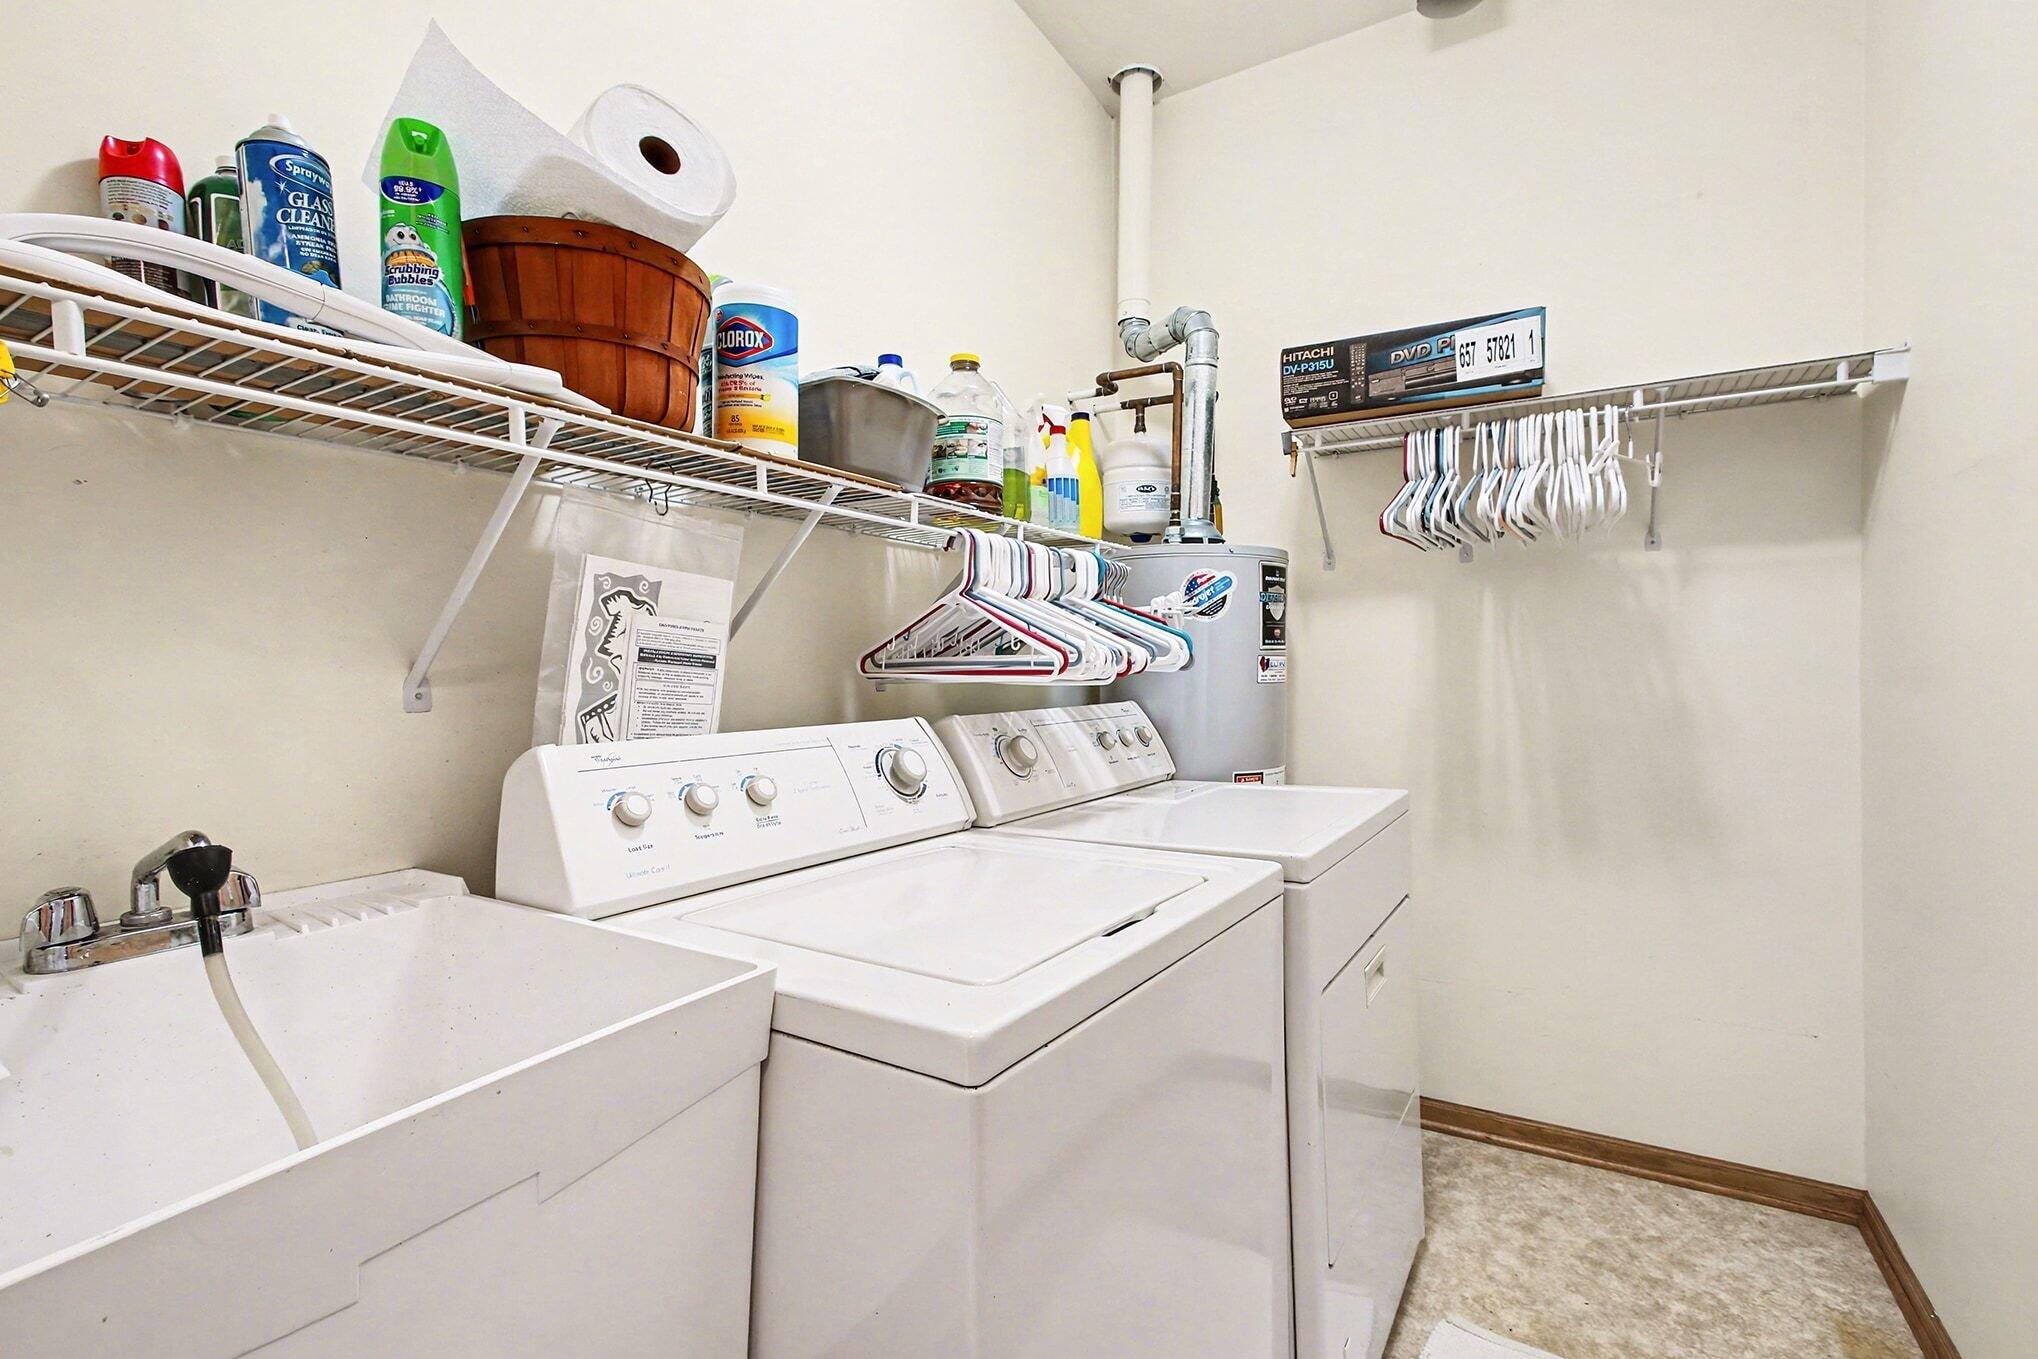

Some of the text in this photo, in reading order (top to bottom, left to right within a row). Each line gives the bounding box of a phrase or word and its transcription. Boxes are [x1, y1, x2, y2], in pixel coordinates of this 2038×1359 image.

[288, 191, 333, 216] GLASS
[384, 263, 440, 280] Scrubbing
[388, 273, 434, 286] Bubbles
[386, 294, 437, 307] BATHROOM
[405, 304, 446, 318] FIGHTER
[717, 330, 764, 350] CLOROX
[1459, 329, 1535, 368] 657 57821 1
[1282, 346, 1335, 363] HITACHI
[1390, 342, 1433, 366] DVD
[1282, 359, 1335, 376] DV-P315U
